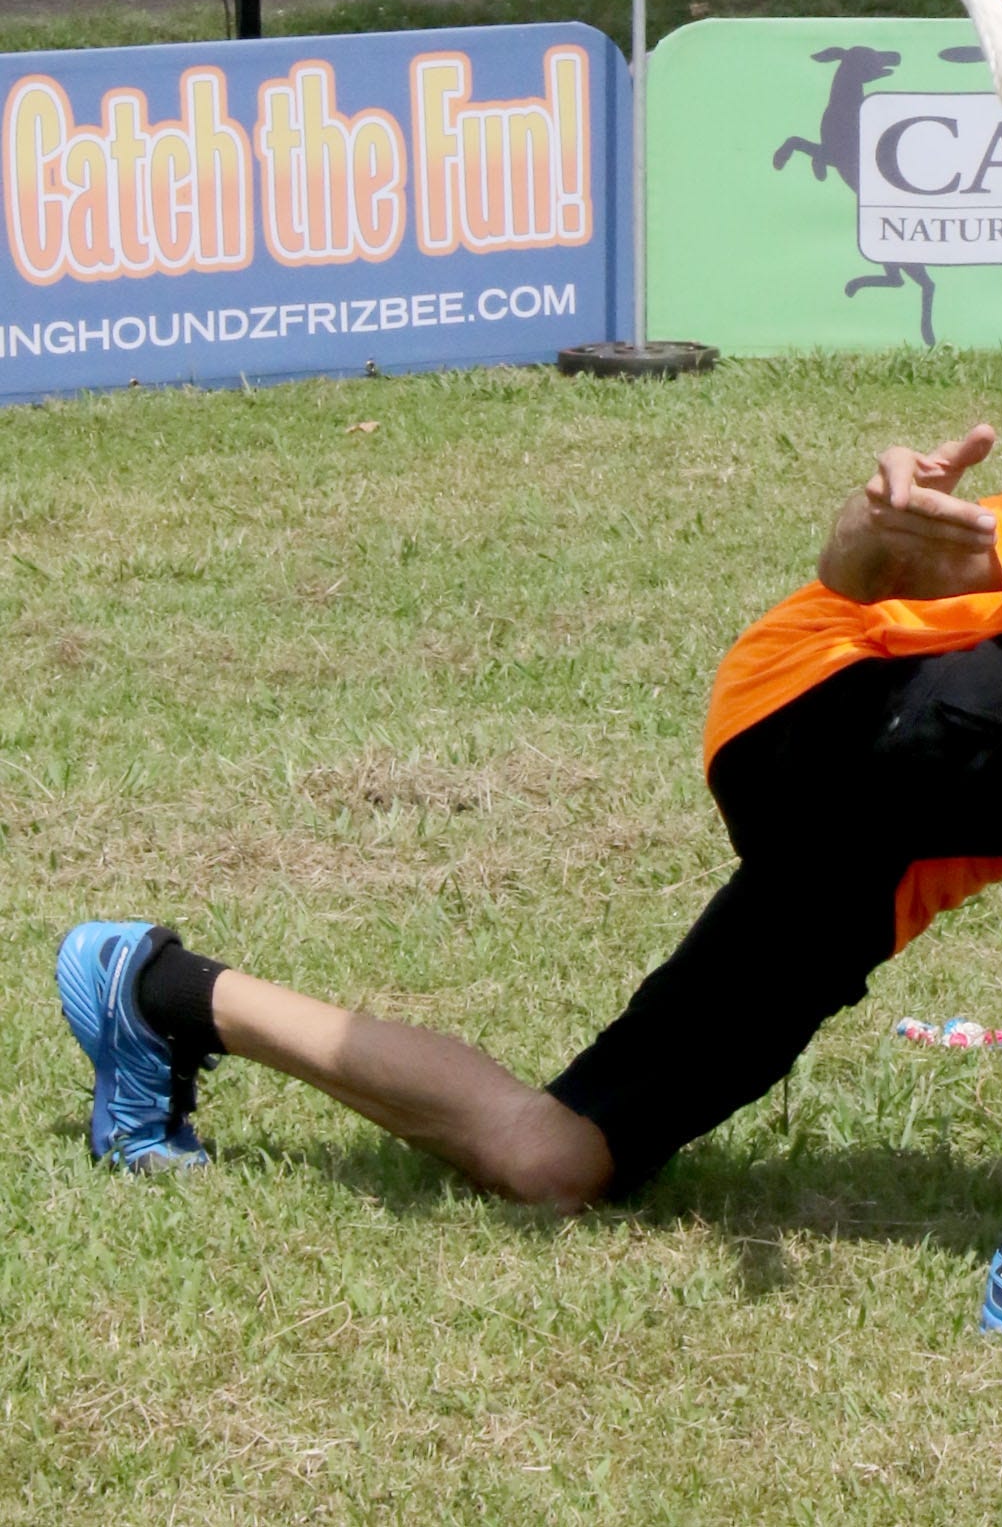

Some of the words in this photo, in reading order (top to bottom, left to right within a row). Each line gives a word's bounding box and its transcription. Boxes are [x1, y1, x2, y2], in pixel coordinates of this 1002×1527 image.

[5, 69, 252, 283] Catch
[256, 61, 404, 264] the
[411, 46, 592, 256] Fun!
